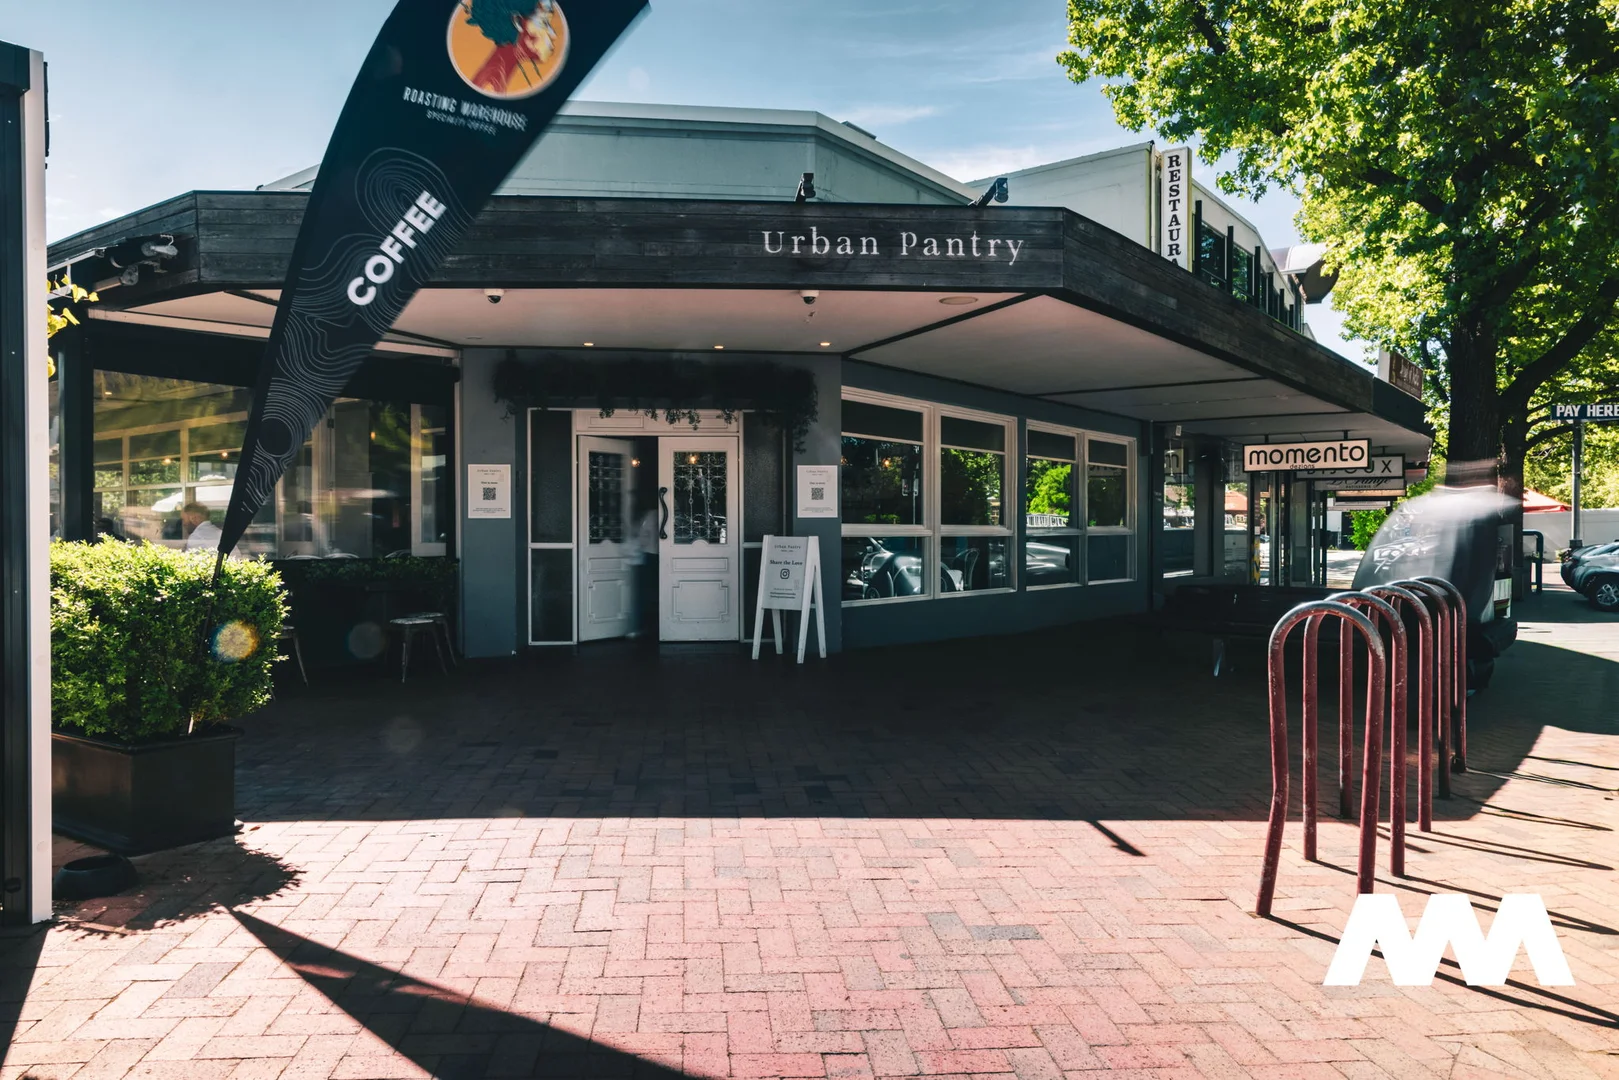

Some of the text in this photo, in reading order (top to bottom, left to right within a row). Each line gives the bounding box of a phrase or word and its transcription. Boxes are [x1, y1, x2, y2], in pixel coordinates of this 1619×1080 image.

[403, 86, 528, 132] ROASTING WAREHOUSE
[347, 190, 447, 305] COFFEE
[762, 226, 1024, 266] Urban Pantry
[1556, 404, 1619, 416] PAY HERE
[1249, 443, 1364, 465] momento
